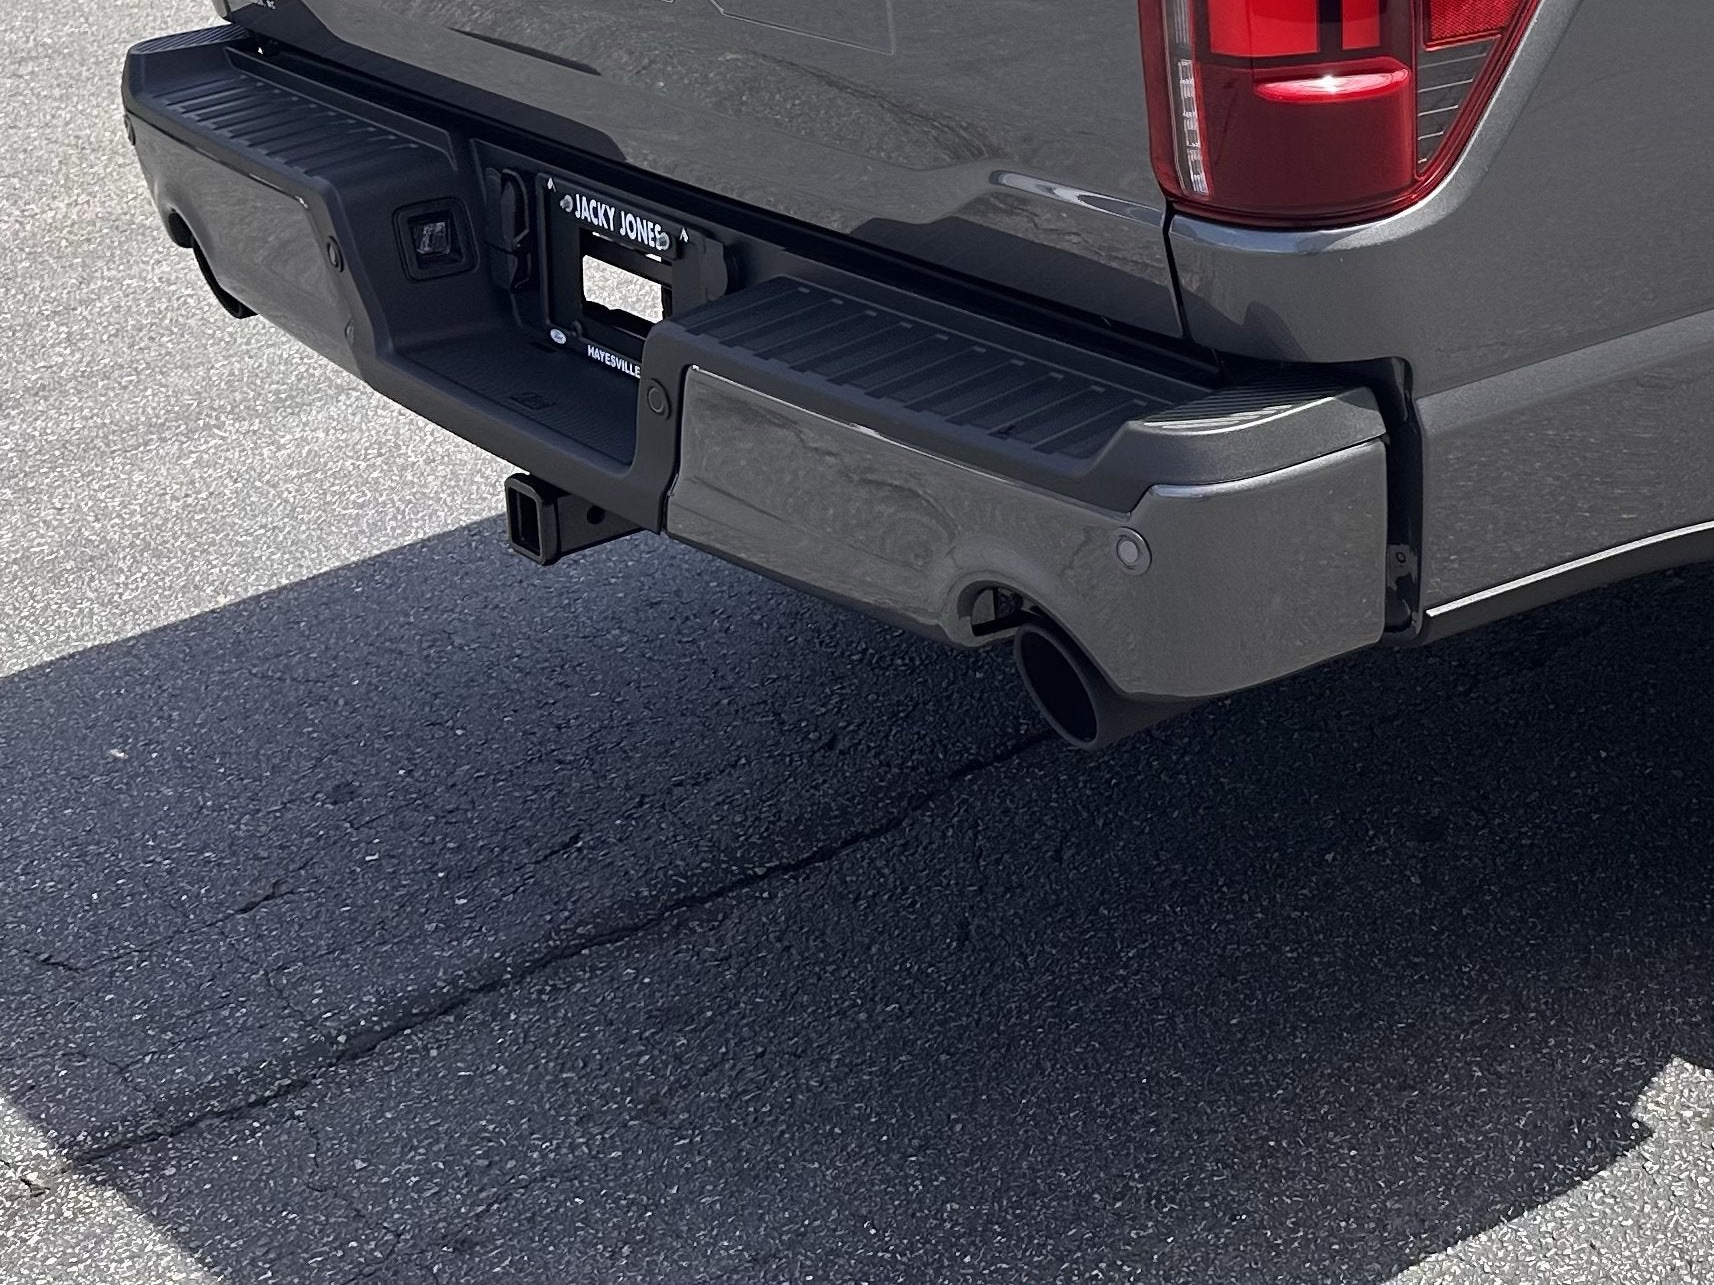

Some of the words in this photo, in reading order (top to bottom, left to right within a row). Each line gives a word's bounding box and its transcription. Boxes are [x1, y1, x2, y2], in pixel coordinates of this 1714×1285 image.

[574, 193, 616, 232] JACKY
[619, 209, 664, 251] JONES
[586, 343, 642, 380] HAYESVILLE
